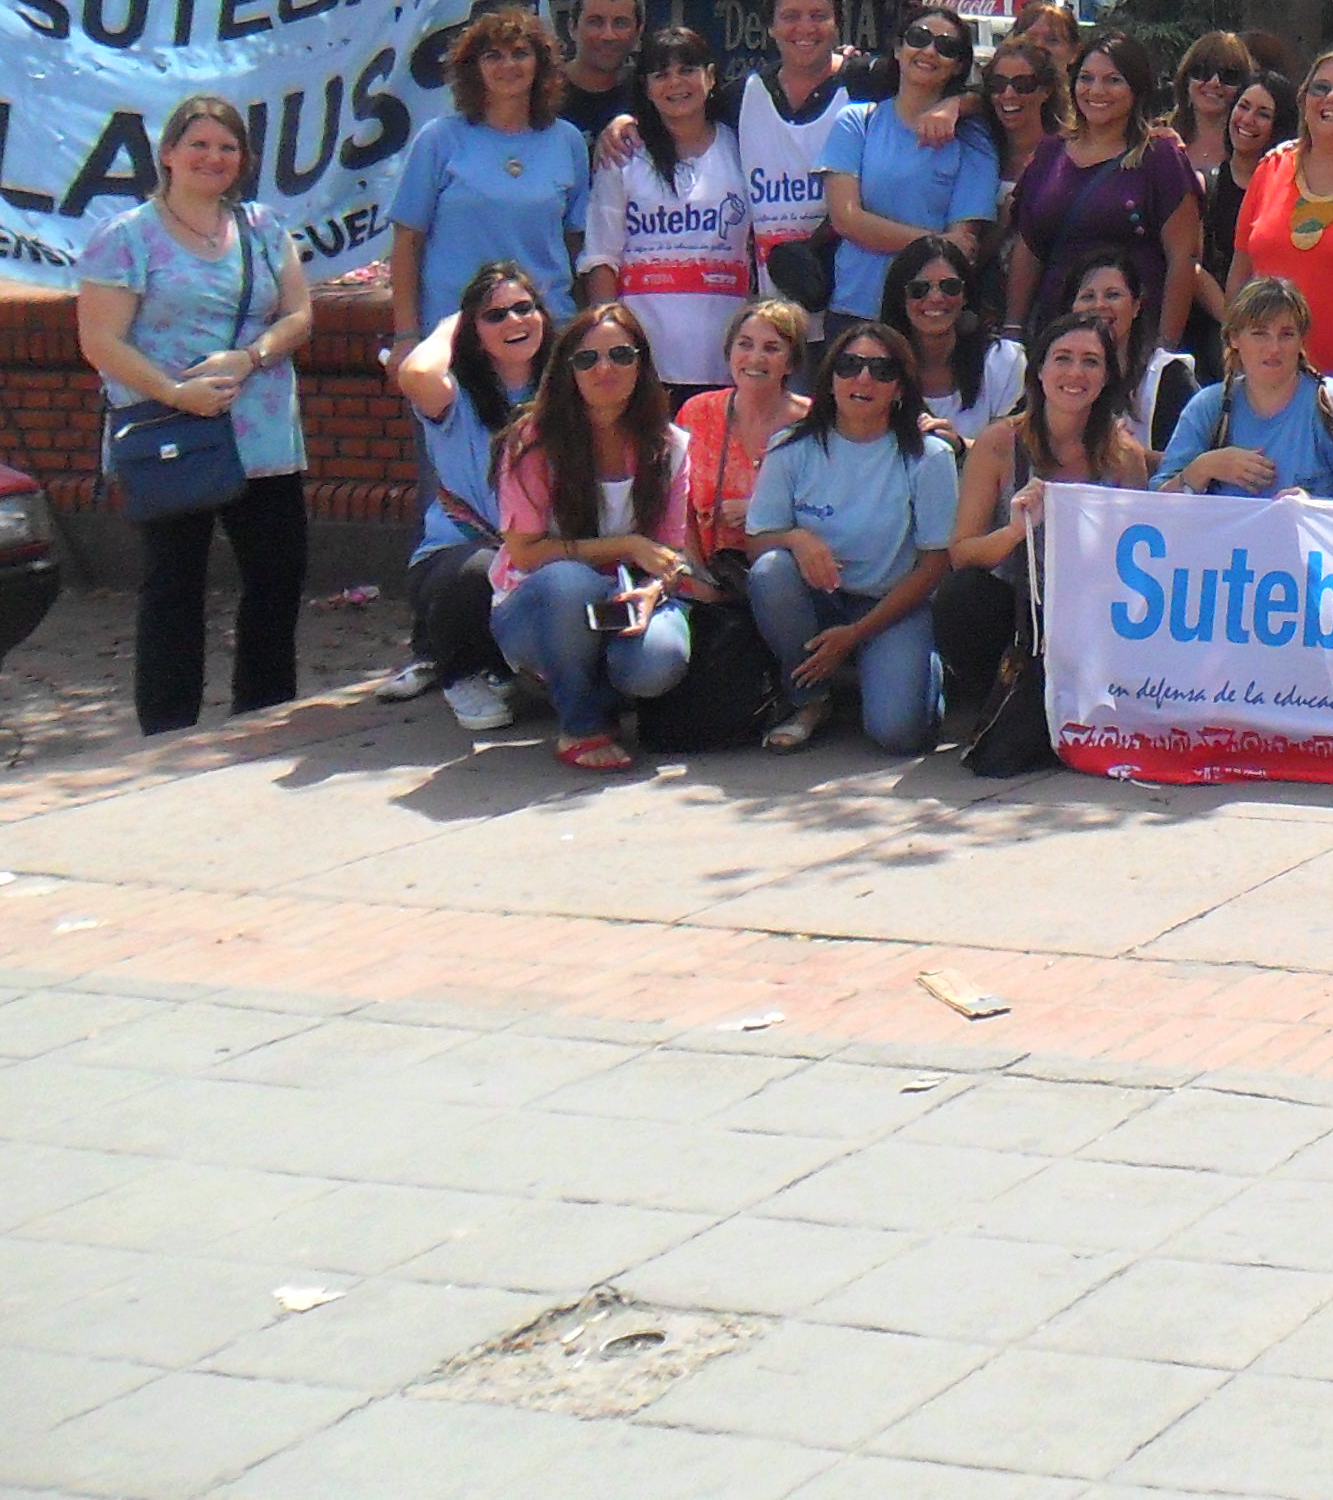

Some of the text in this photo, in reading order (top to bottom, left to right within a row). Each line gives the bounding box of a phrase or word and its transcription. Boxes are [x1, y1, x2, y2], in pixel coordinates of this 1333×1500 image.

[0, 47, 411, 218] LAUS
[750, 167, 824, 204] Suteb
[626, 201, 718, 236] Suteba
[1107, 683, 1131, 698] en
[1136, 677, 1207, 707] defensa
[1213, 680, 1237, 702] de
[1243, 681, 1265, 705] la
